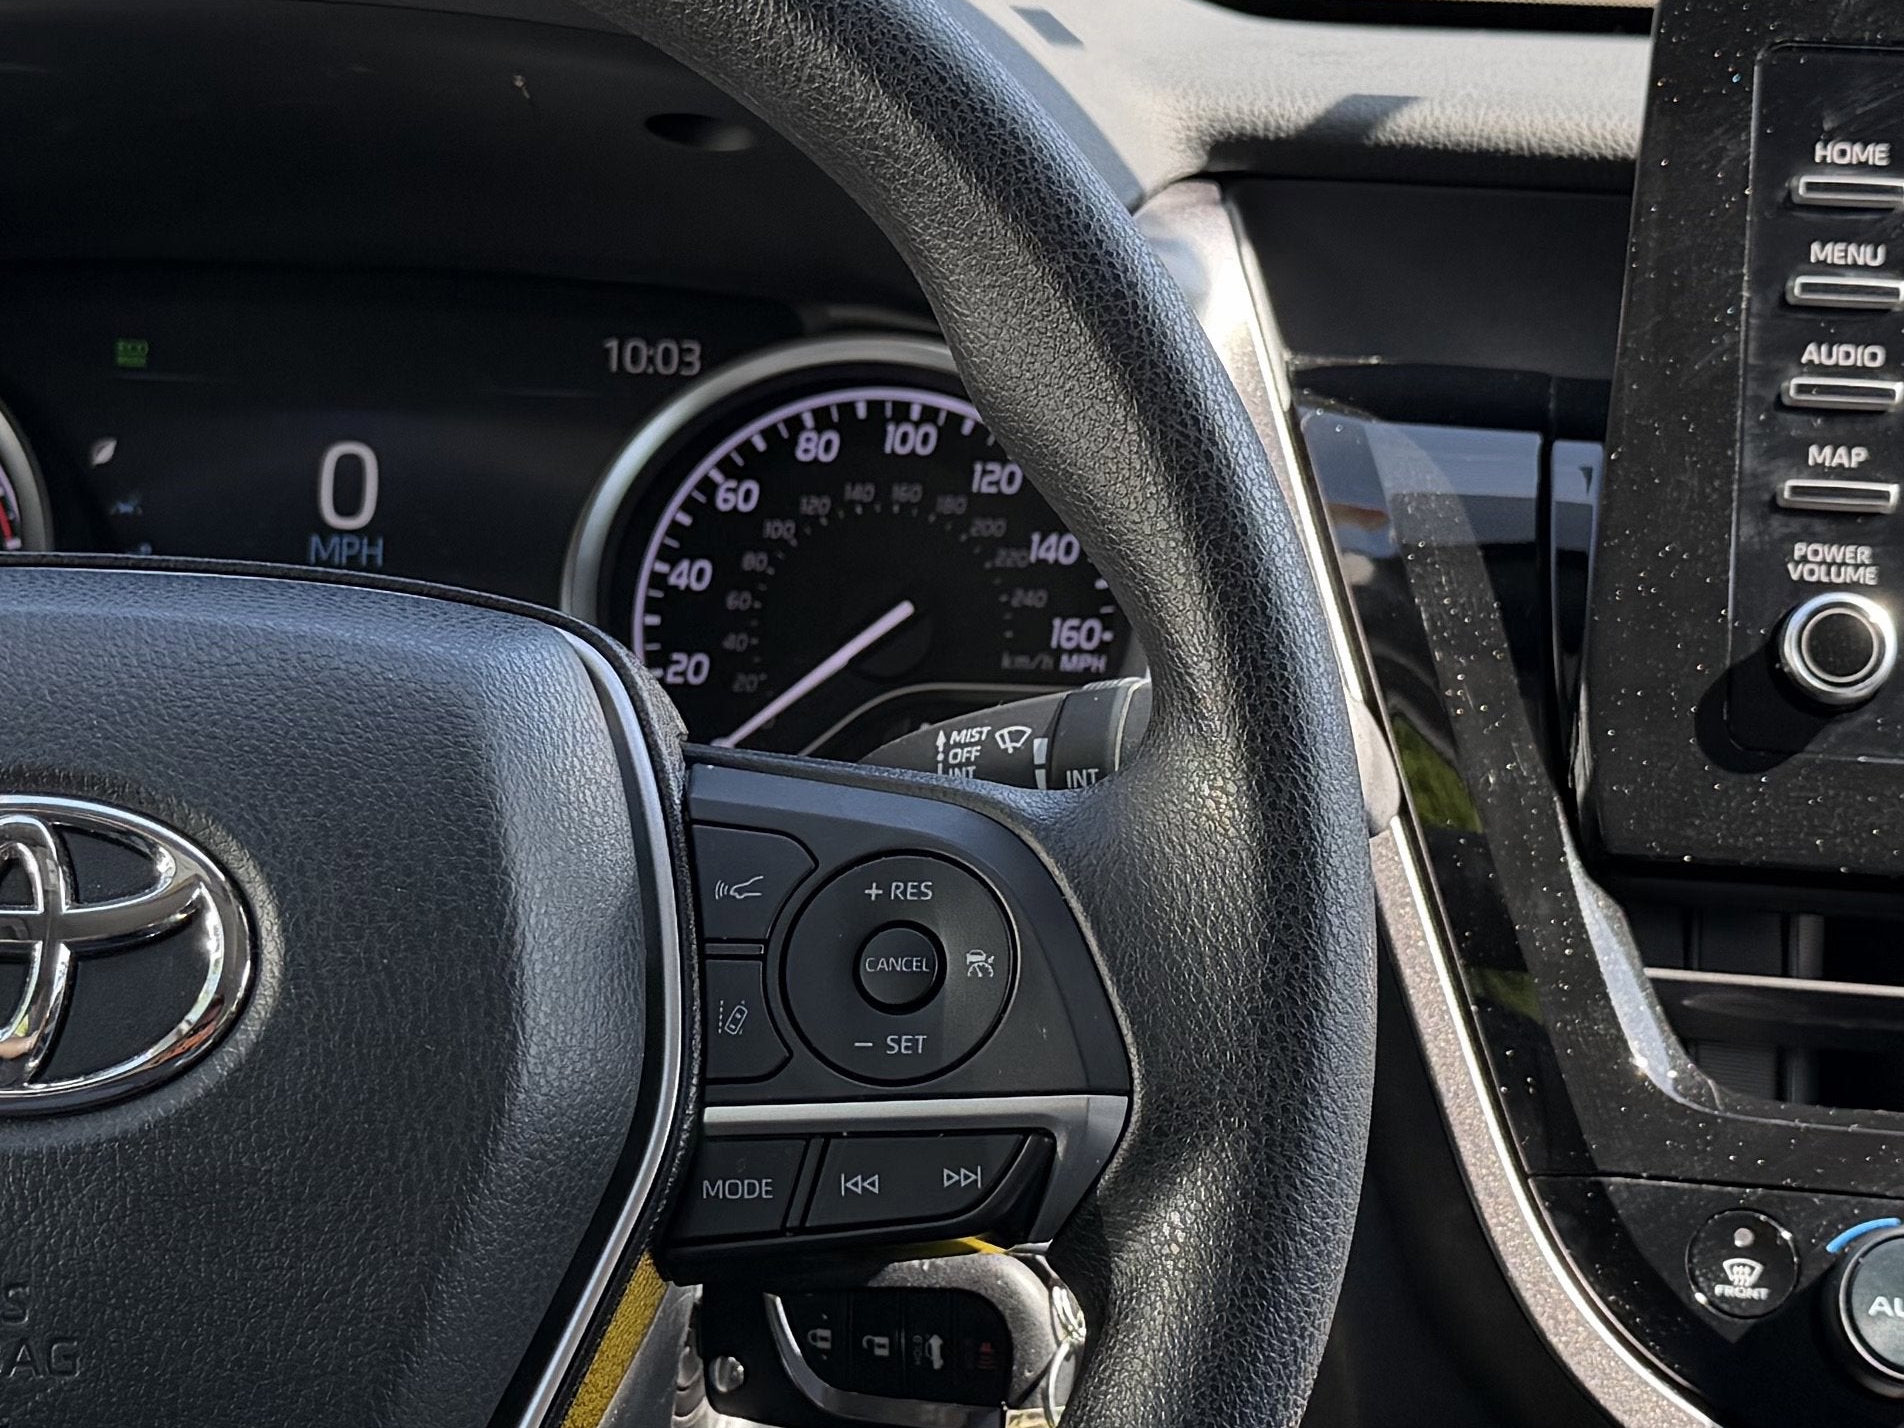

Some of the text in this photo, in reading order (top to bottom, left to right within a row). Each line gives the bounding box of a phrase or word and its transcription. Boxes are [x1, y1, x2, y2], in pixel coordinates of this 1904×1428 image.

[1814, 140, 1892, 166] HOME
[1809, 240, 1887, 267] MENU
[603, 338, 701, 375] 10:03
[1800, 341, 1887, 368] AUDIO
[795, 428, 841, 463] 80
[883, 422, 938, 456] 100
[1808, 444, 1868, 469] MAP
[318, 439, 380, 531] 0
[971, 461, 1024, 495] 120
[714, 478, 760, 513] 60
[762, 517, 796, 541] 100
[307, 532, 384, 568] MPH
[1029, 531, 1081, 566] 140
[1793, 541, 1874, 565] POWER
[667, 557, 713, 592] 40
[1787, 561, 1880, 586] VOLUME
[725, 589, 753, 612] 60
[1050, 617, 1103, 652] 160
[666, 652, 711, 686] 20
[1059, 652, 1107, 673] MPH
[949, 727, 992, 745] MIST
[948, 746, 981, 765] OFF
[1066, 769, 1099, 790] INT
[890, 881, 933, 901] RES
[865, 956, 930, 973] CANCEL
[886, 1035, 928, 1055] SET
[702, 1180, 774, 1200] MODE
[1714, 1285, 1770, 1300] FRONT
